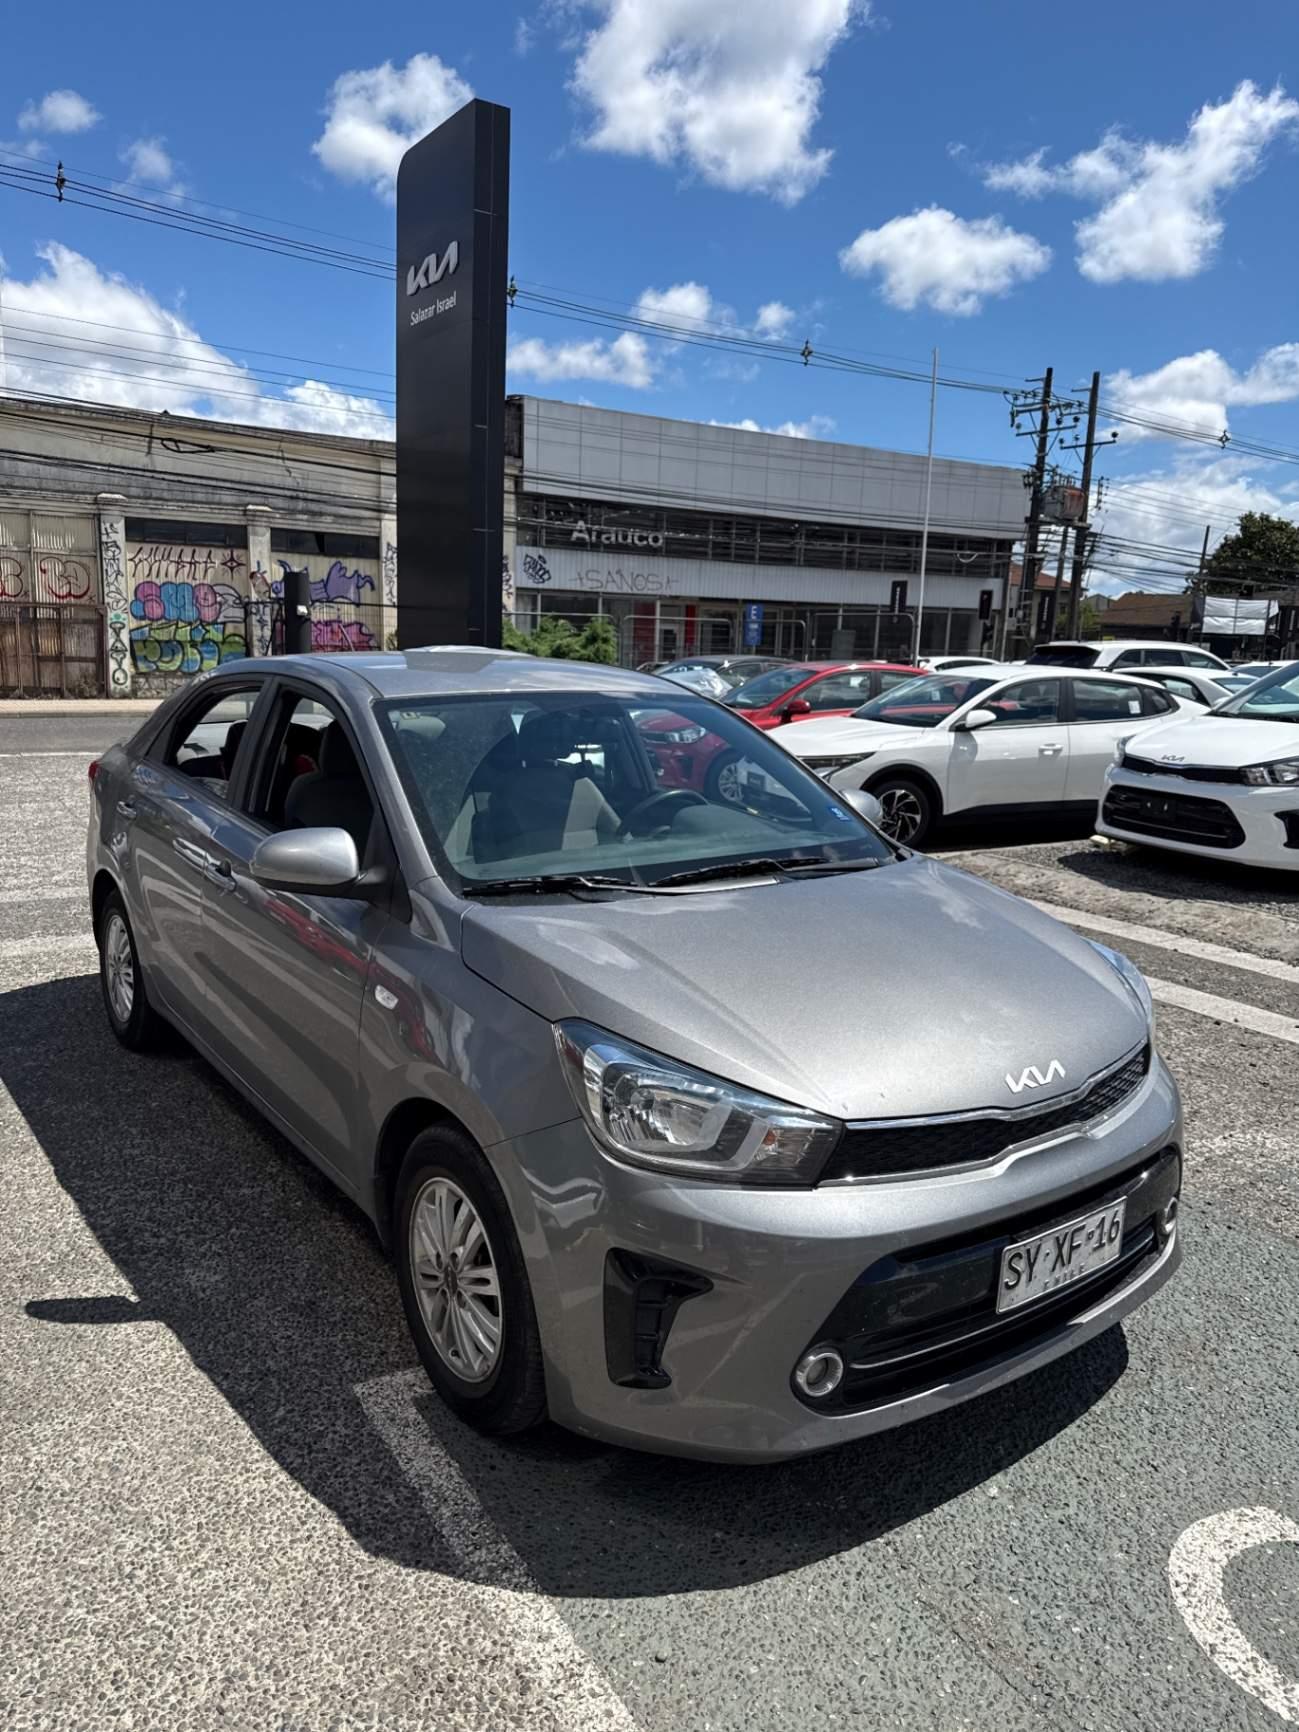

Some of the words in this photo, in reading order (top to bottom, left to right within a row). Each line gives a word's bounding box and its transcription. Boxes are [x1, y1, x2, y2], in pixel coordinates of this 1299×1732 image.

[410, 304, 436, 327] Salazar
[436, 290, 457, 315] Israel
[570, 519, 664, 547] Arauco
[1005, 1059, 1066, 1094] KIA
